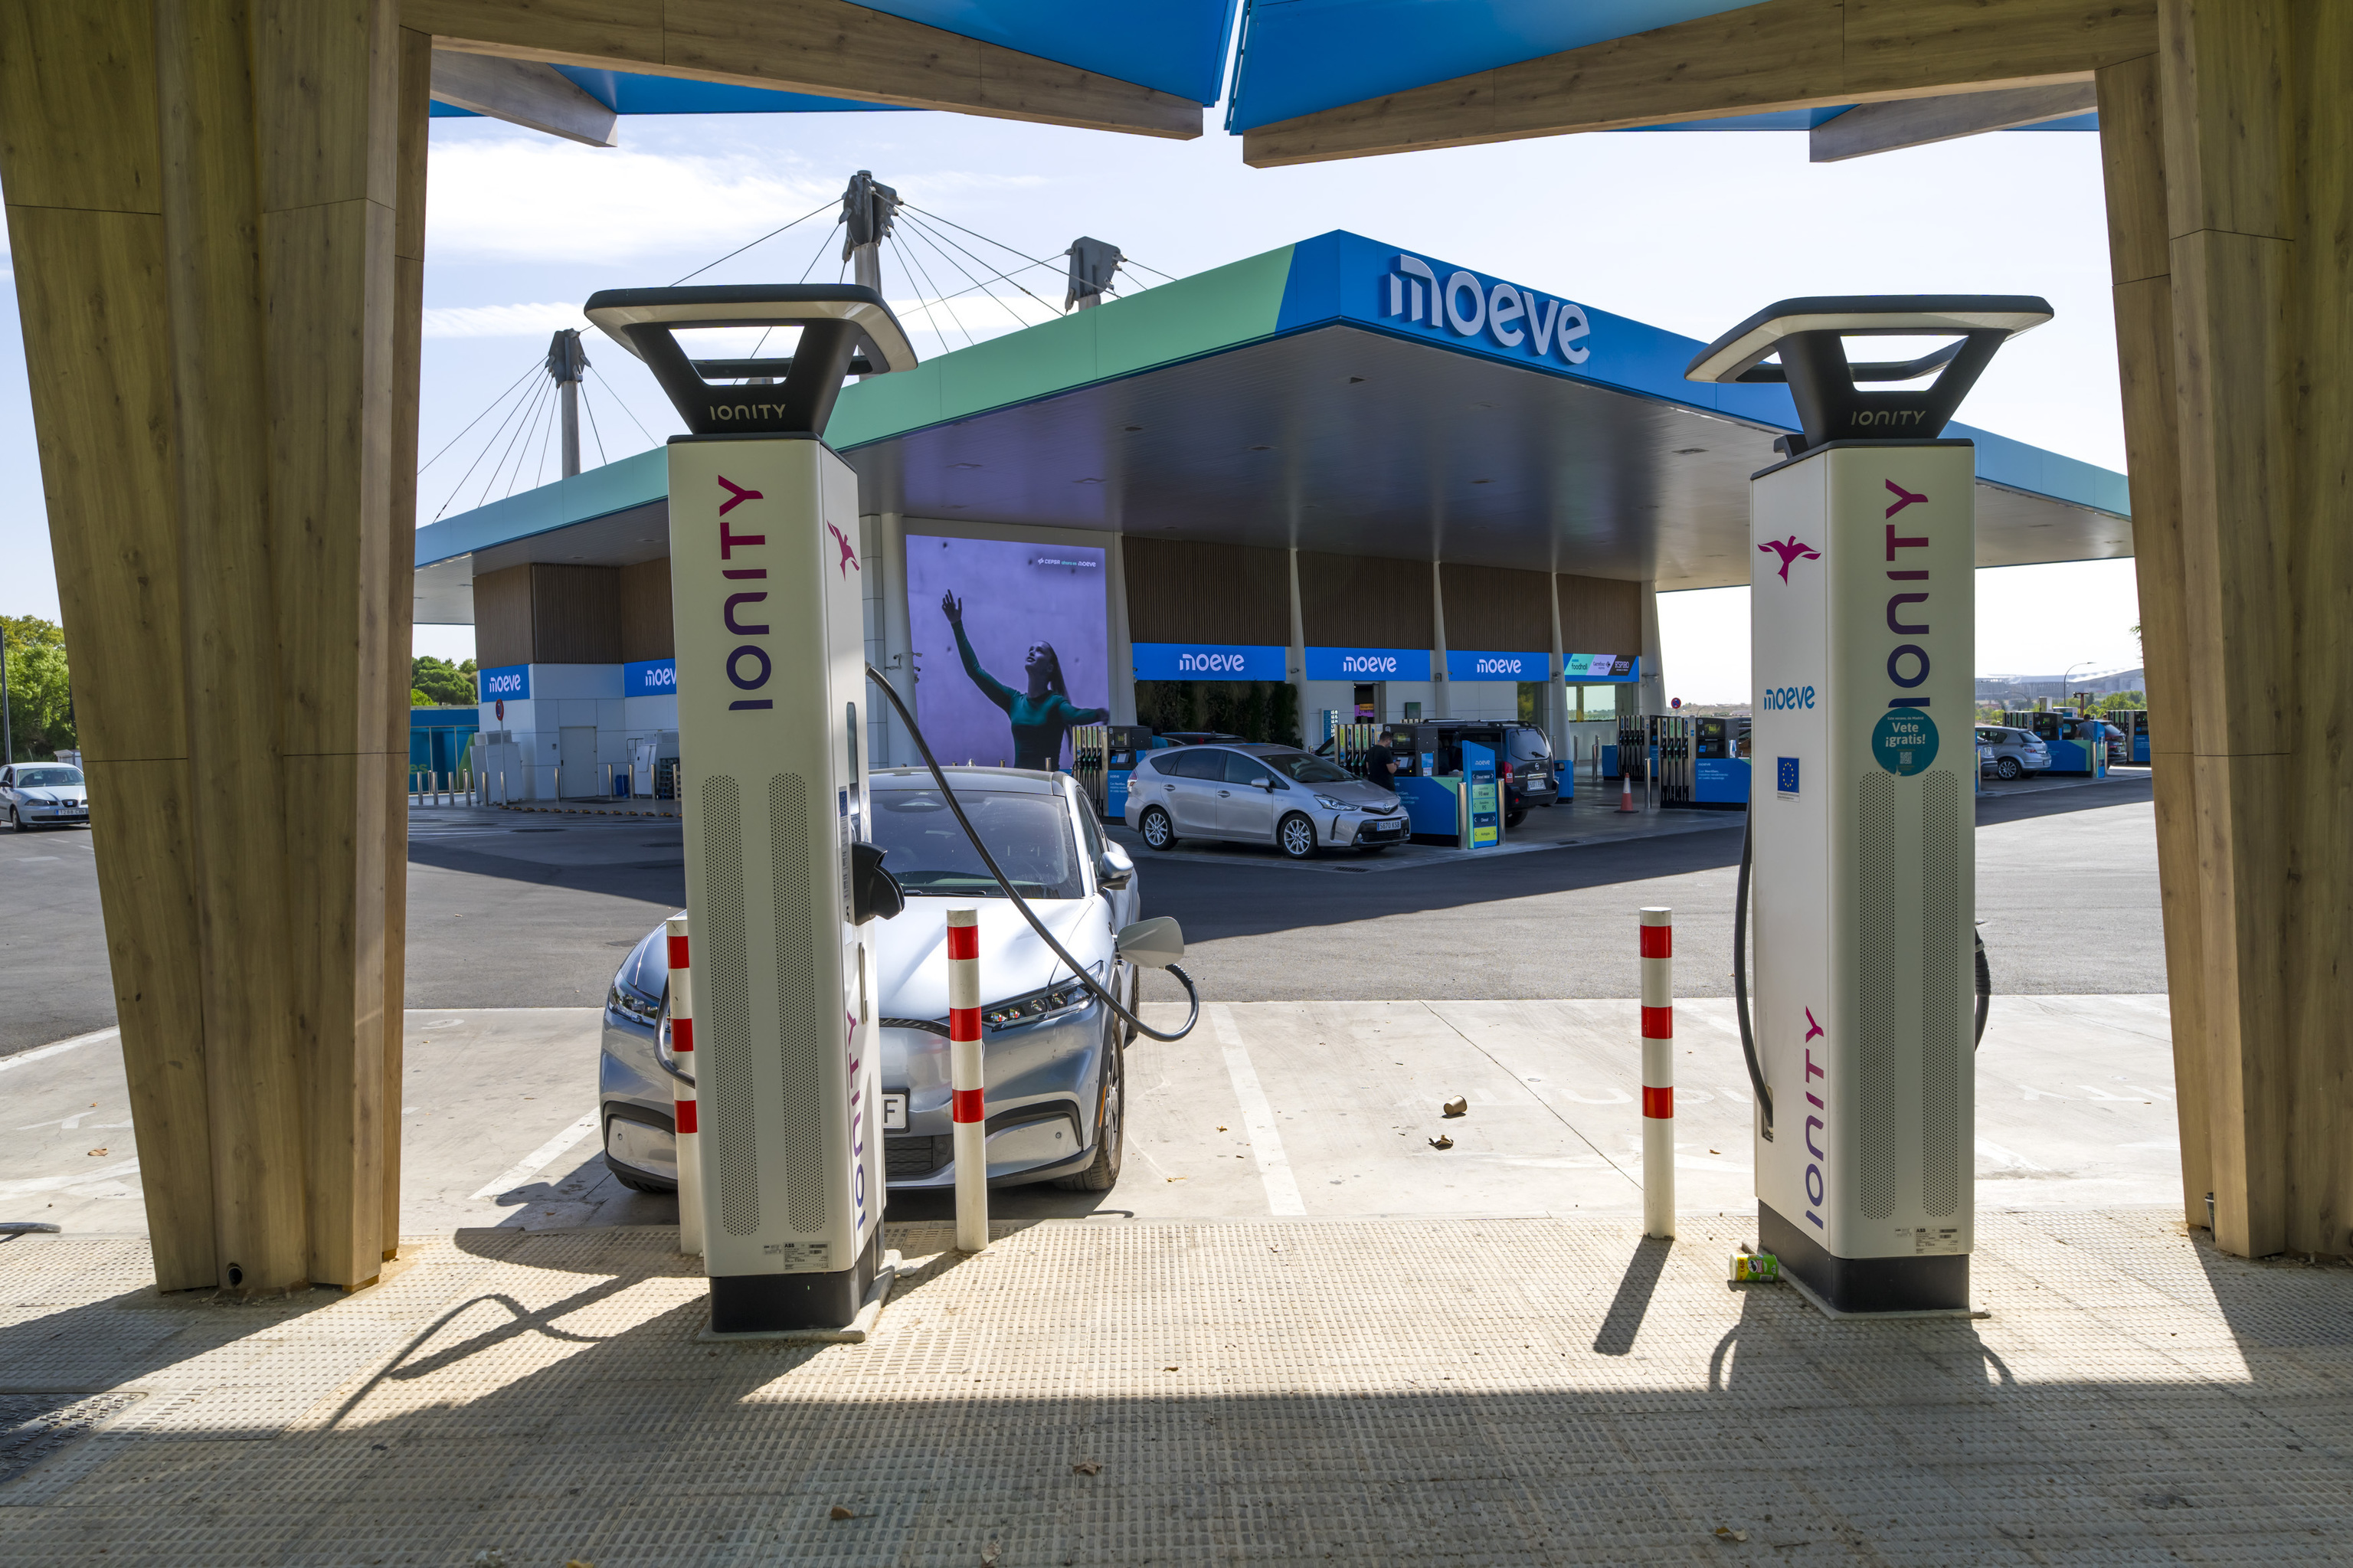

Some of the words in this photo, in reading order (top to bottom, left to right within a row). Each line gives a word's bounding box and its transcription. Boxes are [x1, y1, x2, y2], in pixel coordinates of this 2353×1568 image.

[1389, 253, 1591, 365] moeve
[710, 404, 786, 421] IONITY
[1851, 410, 1926, 426] IONITY
[717, 474, 774, 712] IONITY
[1885, 478, 1931, 709] IONITY
[1179, 653, 1245, 672] moeve
[1343, 656, 1397, 673] moeve
[1477, 659, 1522, 674] moeve
[489, 673, 522, 693] moeve
[1763, 685, 1815, 711] moeve
[1892, 722, 1919, 733] Vete
[1885, 734, 1926, 748] ¡gratis!
[846, 1009, 866, 1232] IONITY
[1805, 1005, 1824, 1230] IONITY
